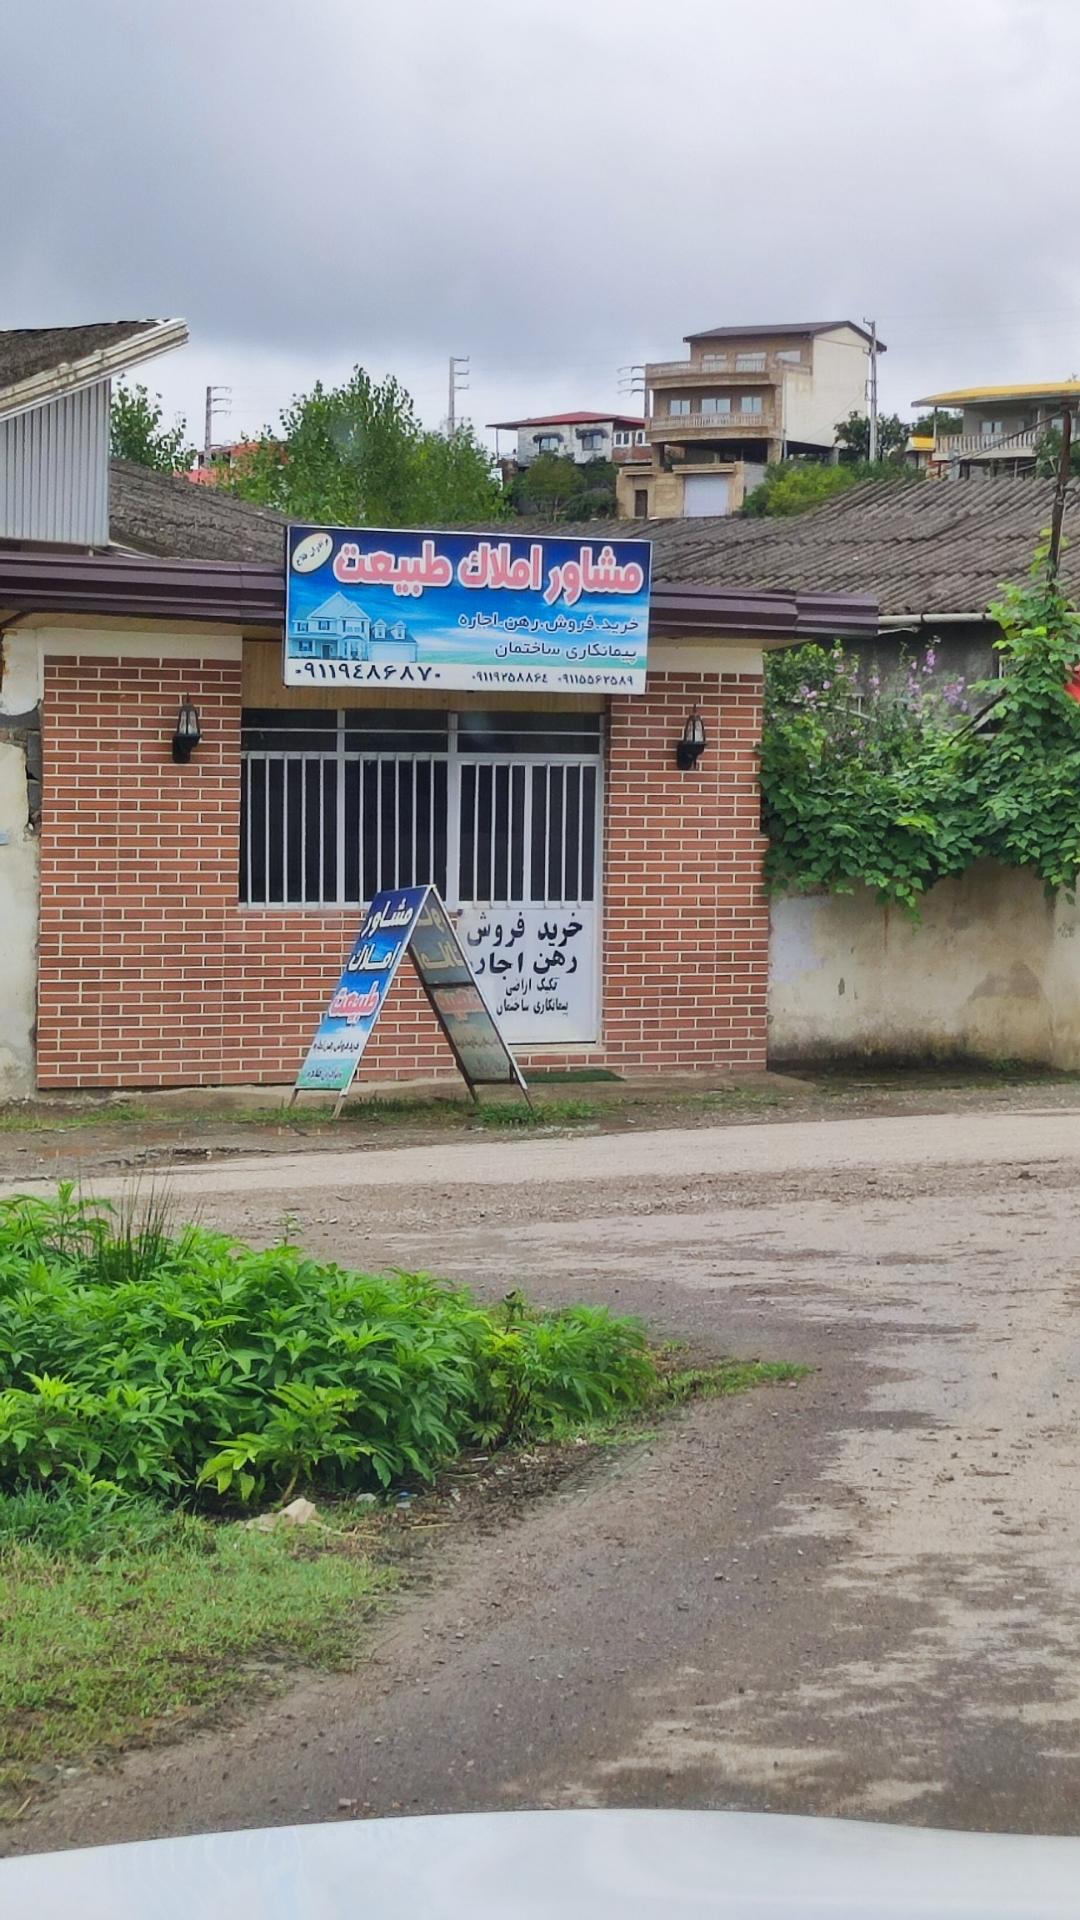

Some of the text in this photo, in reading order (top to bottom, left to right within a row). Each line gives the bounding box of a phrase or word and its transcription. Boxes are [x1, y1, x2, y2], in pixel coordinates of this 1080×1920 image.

[333, 540, 453, 597] طبیعت
[543, 546, 643, 605] مشاور
[495, 641, 637, 663] پیمانکاری ساختمان
[360, 898, 414, 938] مشاور
[467, 912, 525, 947] فروش
[538, 912, 583, 947] خرید
[470, 950, 578, 980] رهن اجار
[328, 980, 380, 1025] طبیعت
